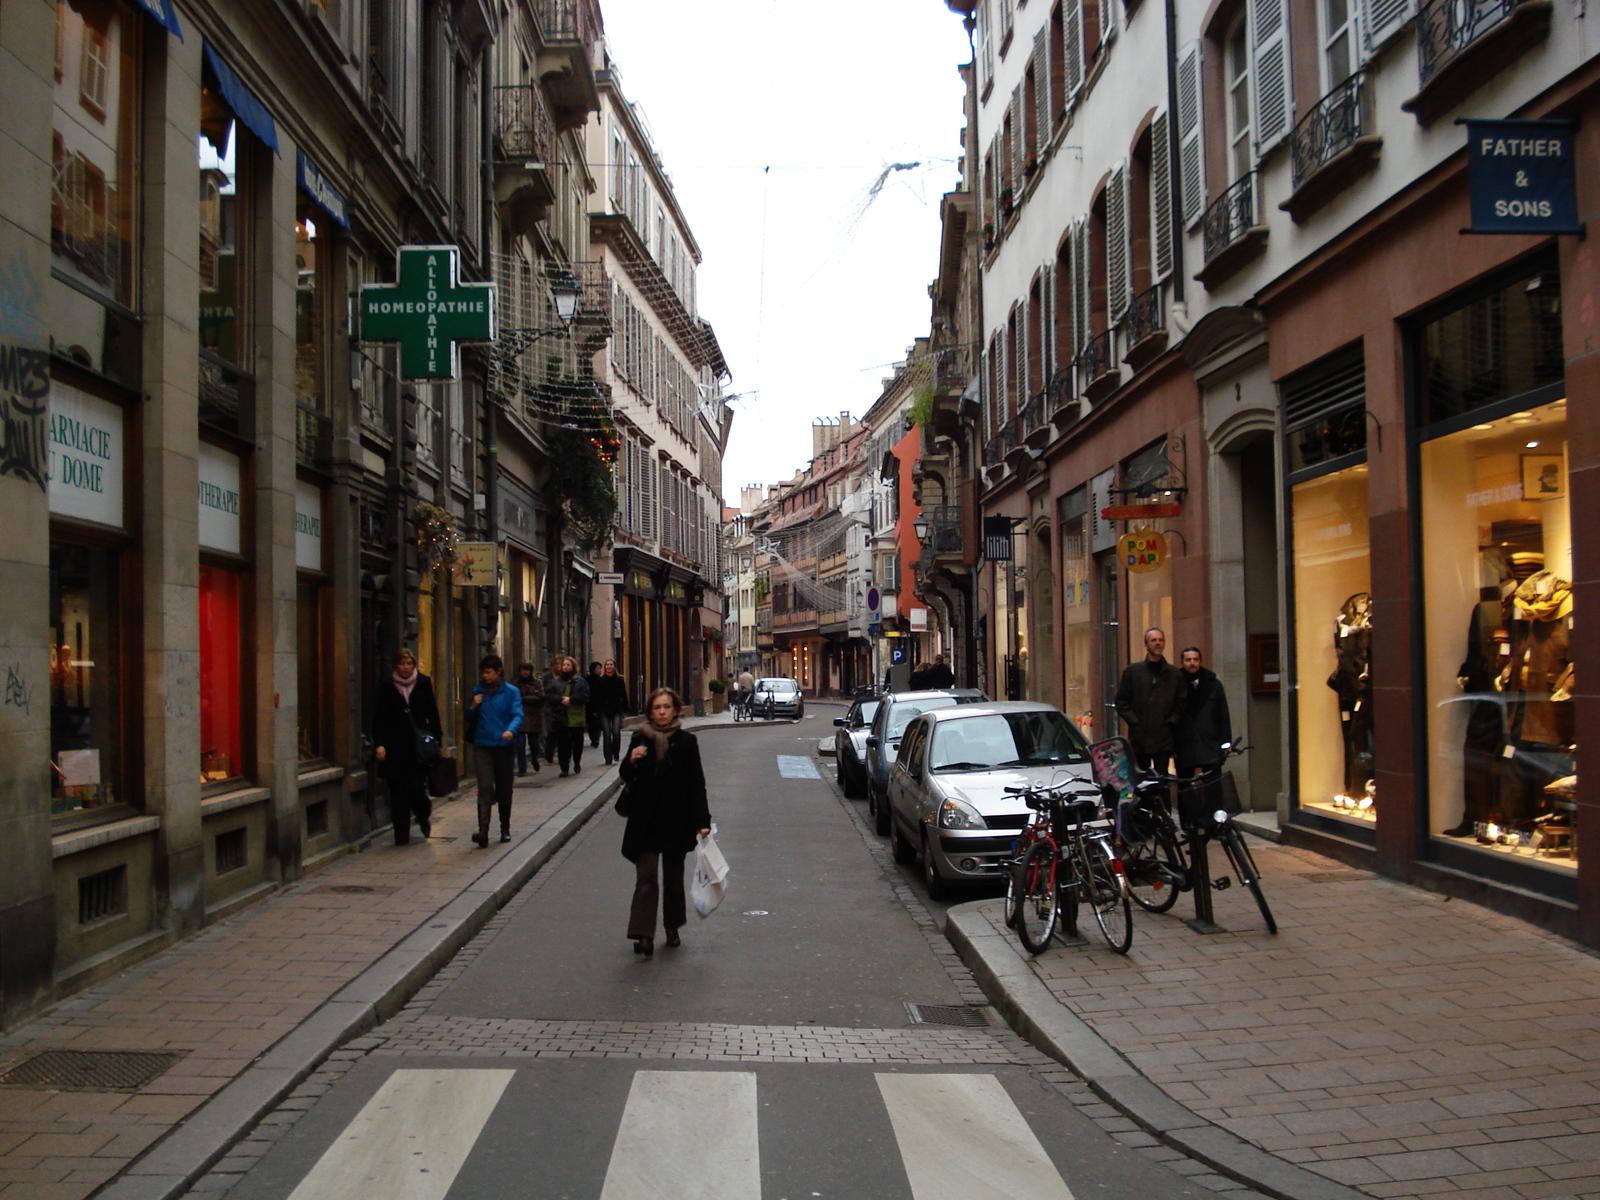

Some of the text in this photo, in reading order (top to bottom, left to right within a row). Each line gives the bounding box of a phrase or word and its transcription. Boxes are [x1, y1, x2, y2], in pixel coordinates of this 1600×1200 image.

[1481, 138, 1562, 156] FATHER
[1515, 170, 1529, 187] &
[1494, 200, 1552, 217] SONS
[368, 301, 484, 314] HOMEOPATHIE
[426, 254, 438, 372] ALLOPATHIE
[62, 454, 103, 494] DOME
[198, 480, 239, 516] THERAPIE
[1127, 540, 1157, 552] POM
[893, 650, 902, 661] P
